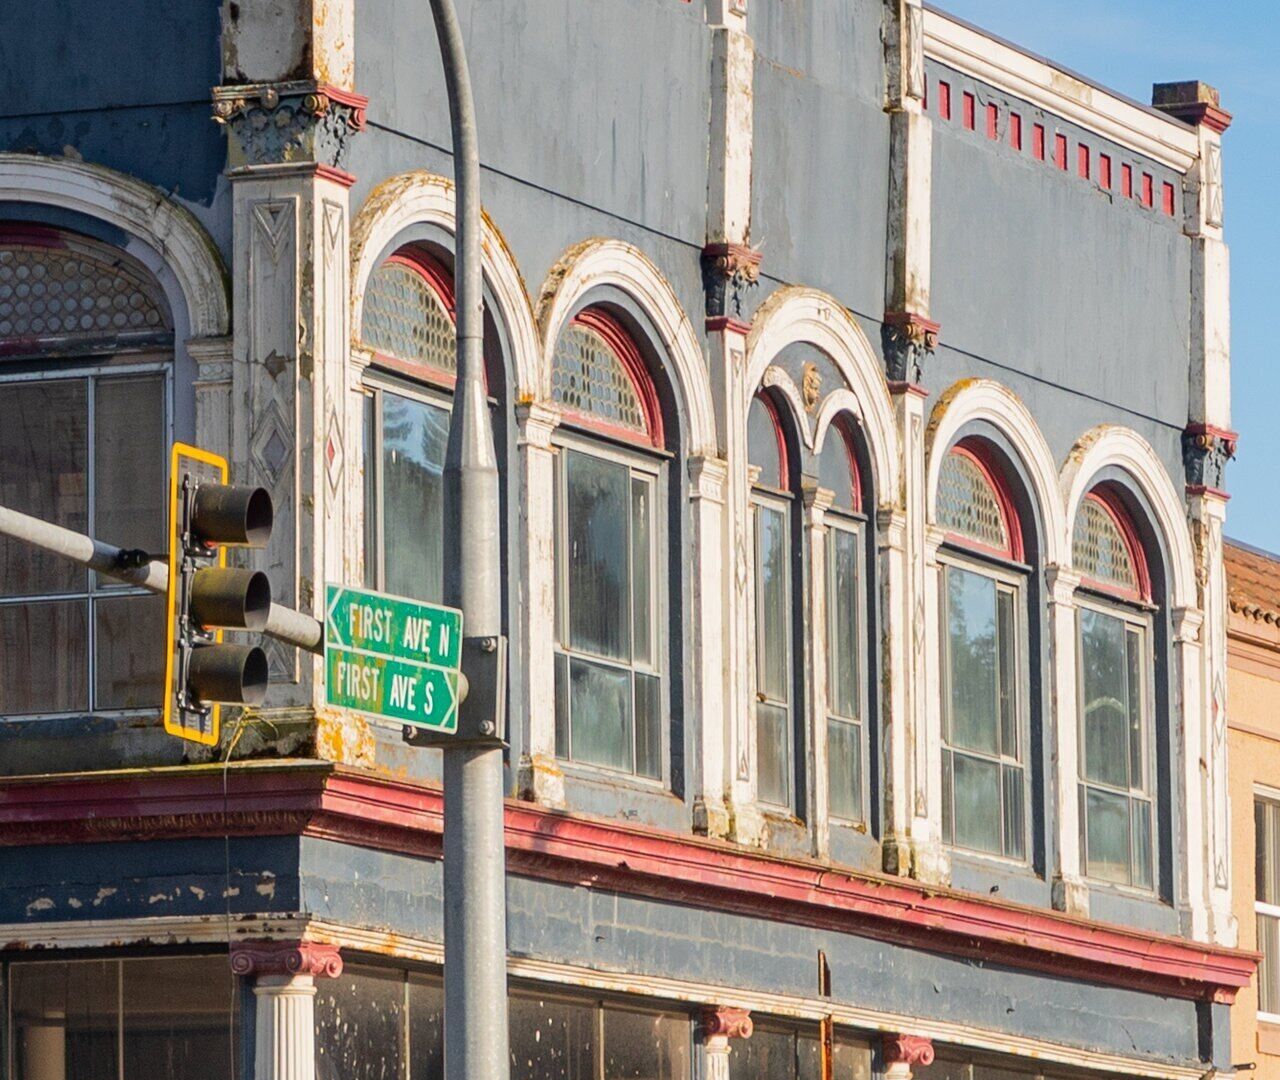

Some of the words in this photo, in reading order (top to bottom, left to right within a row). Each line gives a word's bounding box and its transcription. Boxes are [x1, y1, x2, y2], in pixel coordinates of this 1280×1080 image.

[349, 603, 392, 644] FIRST
[403, 616, 432, 653] AVE
[439, 623, 450, 657] N
[337, 662, 380, 702] FIRST
[389, 675, 417, 711] AVE
[424, 681, 435, 715] S
